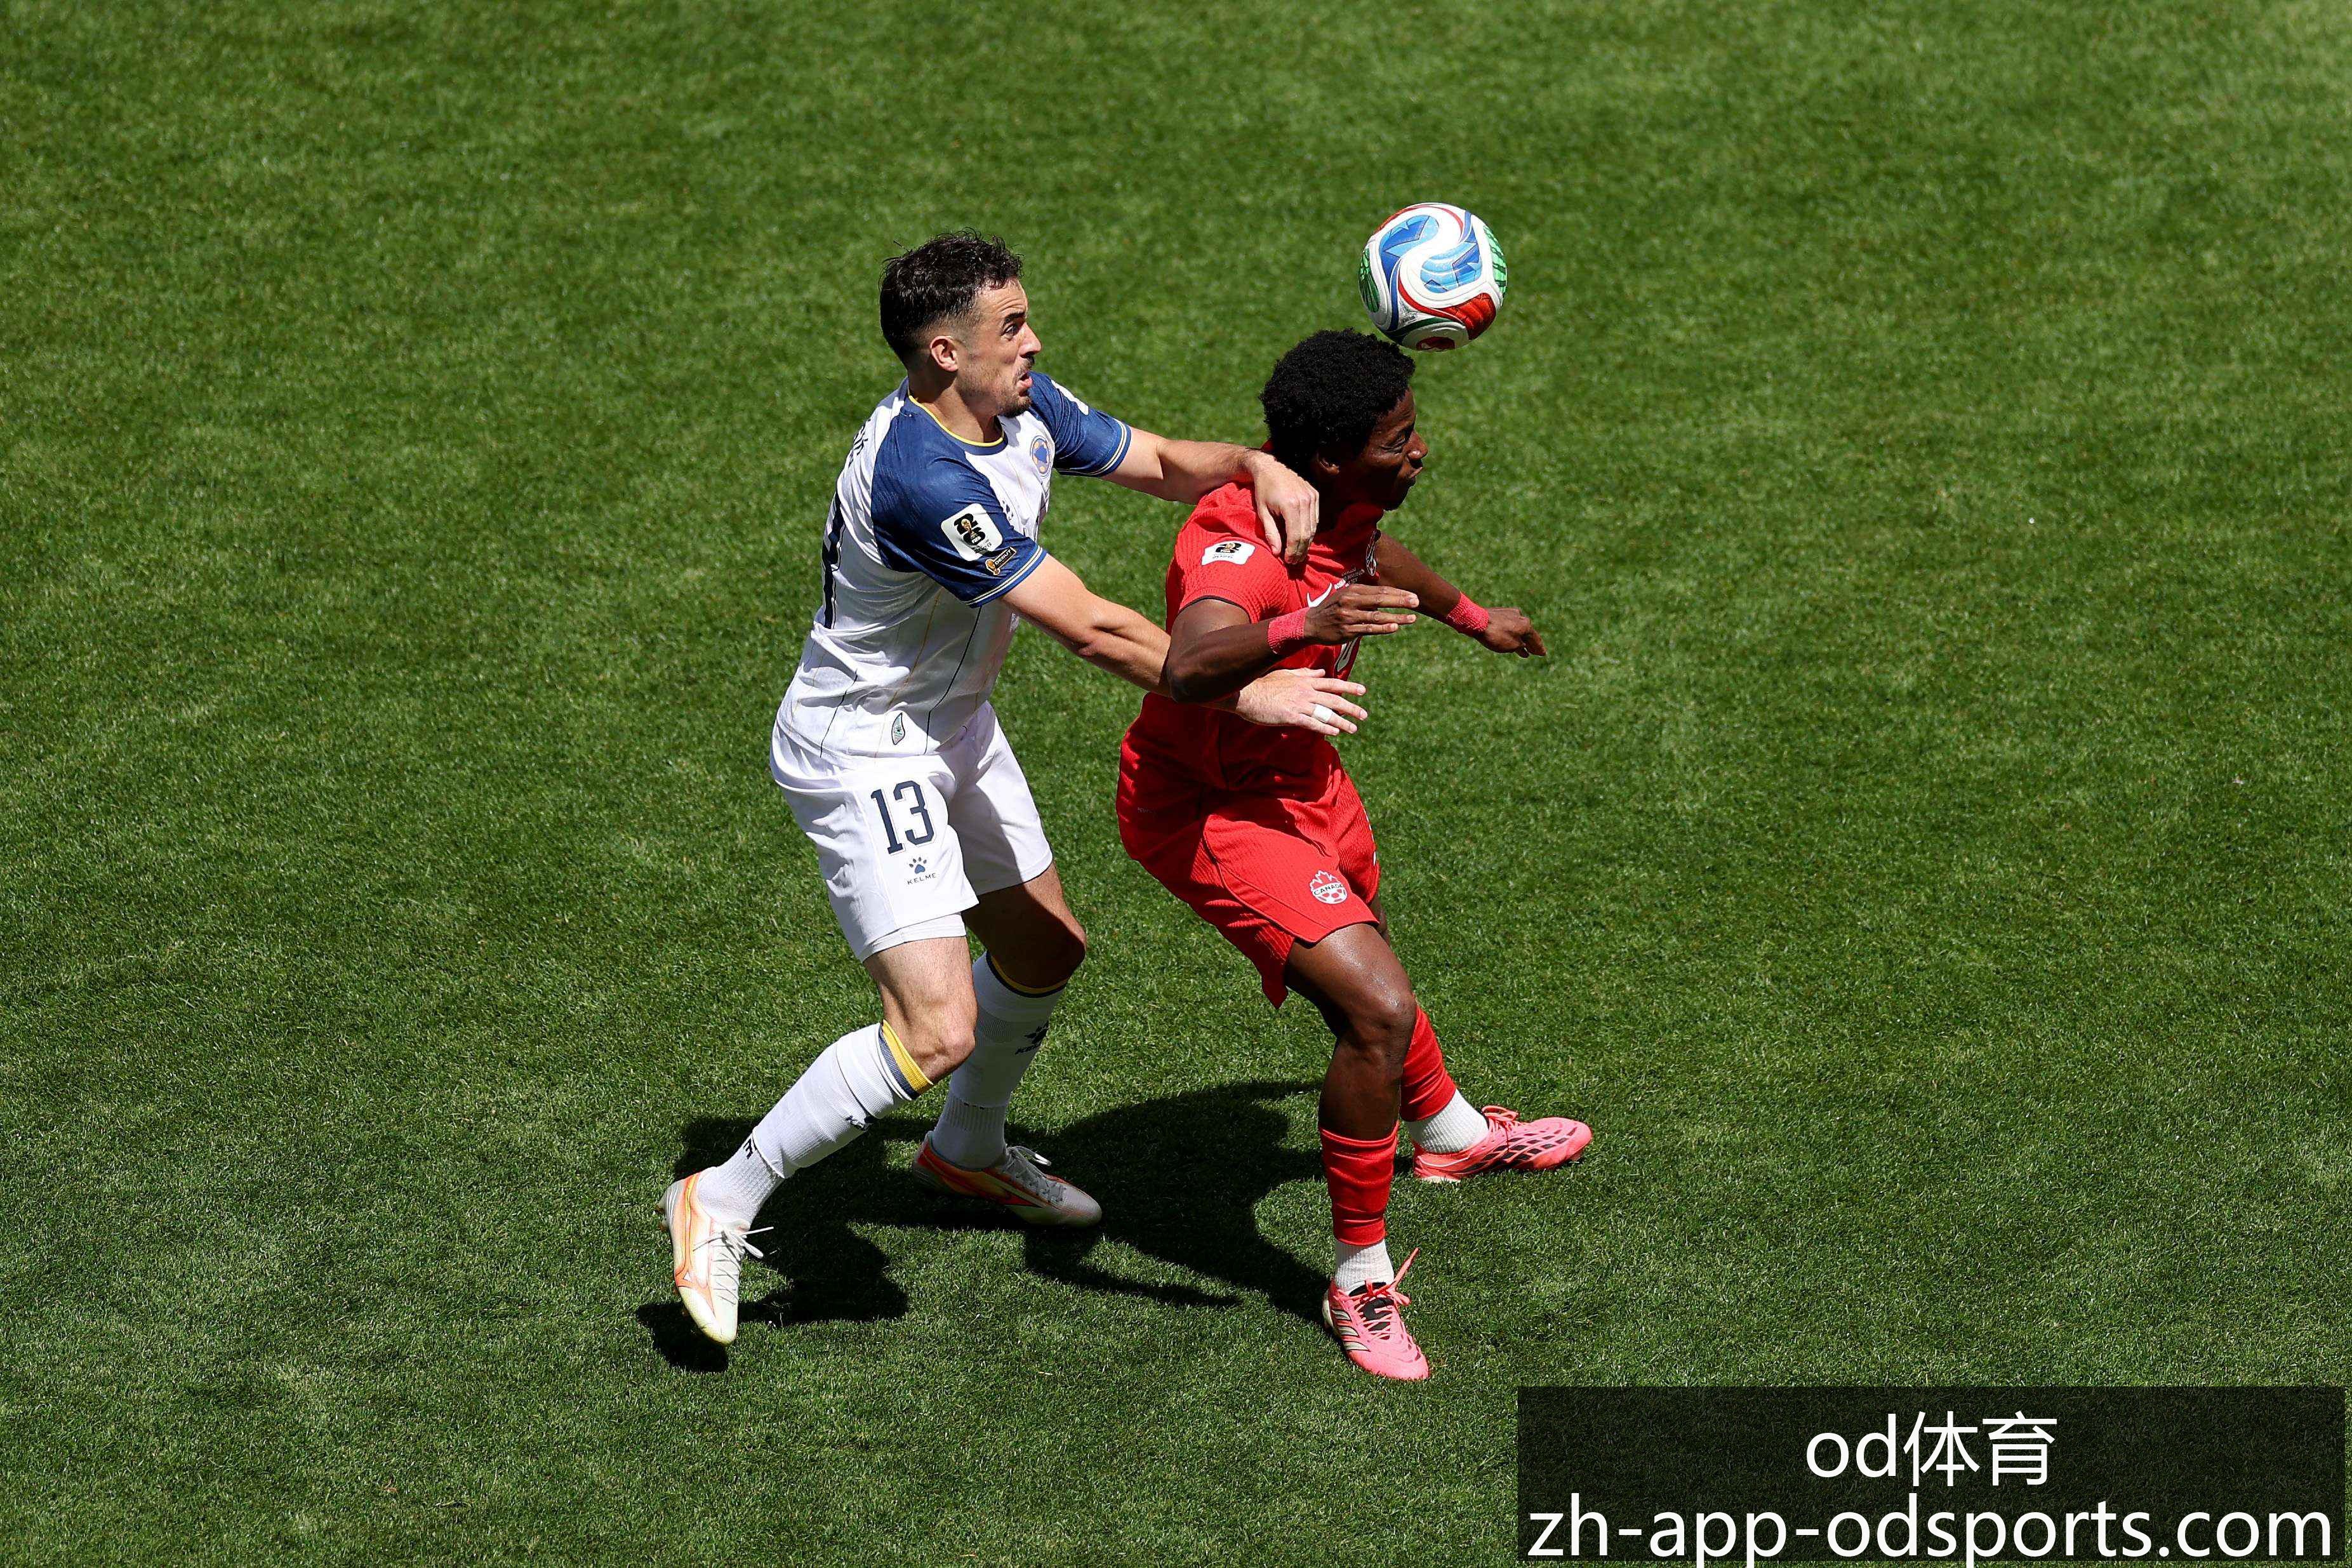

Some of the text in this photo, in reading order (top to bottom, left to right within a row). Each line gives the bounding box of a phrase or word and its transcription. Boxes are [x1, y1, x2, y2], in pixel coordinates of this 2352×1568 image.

[994, 548, 1012, 566] DEBUT
[870, 780, 936, 854] 13
[907, 872, 937, 885] KELME
